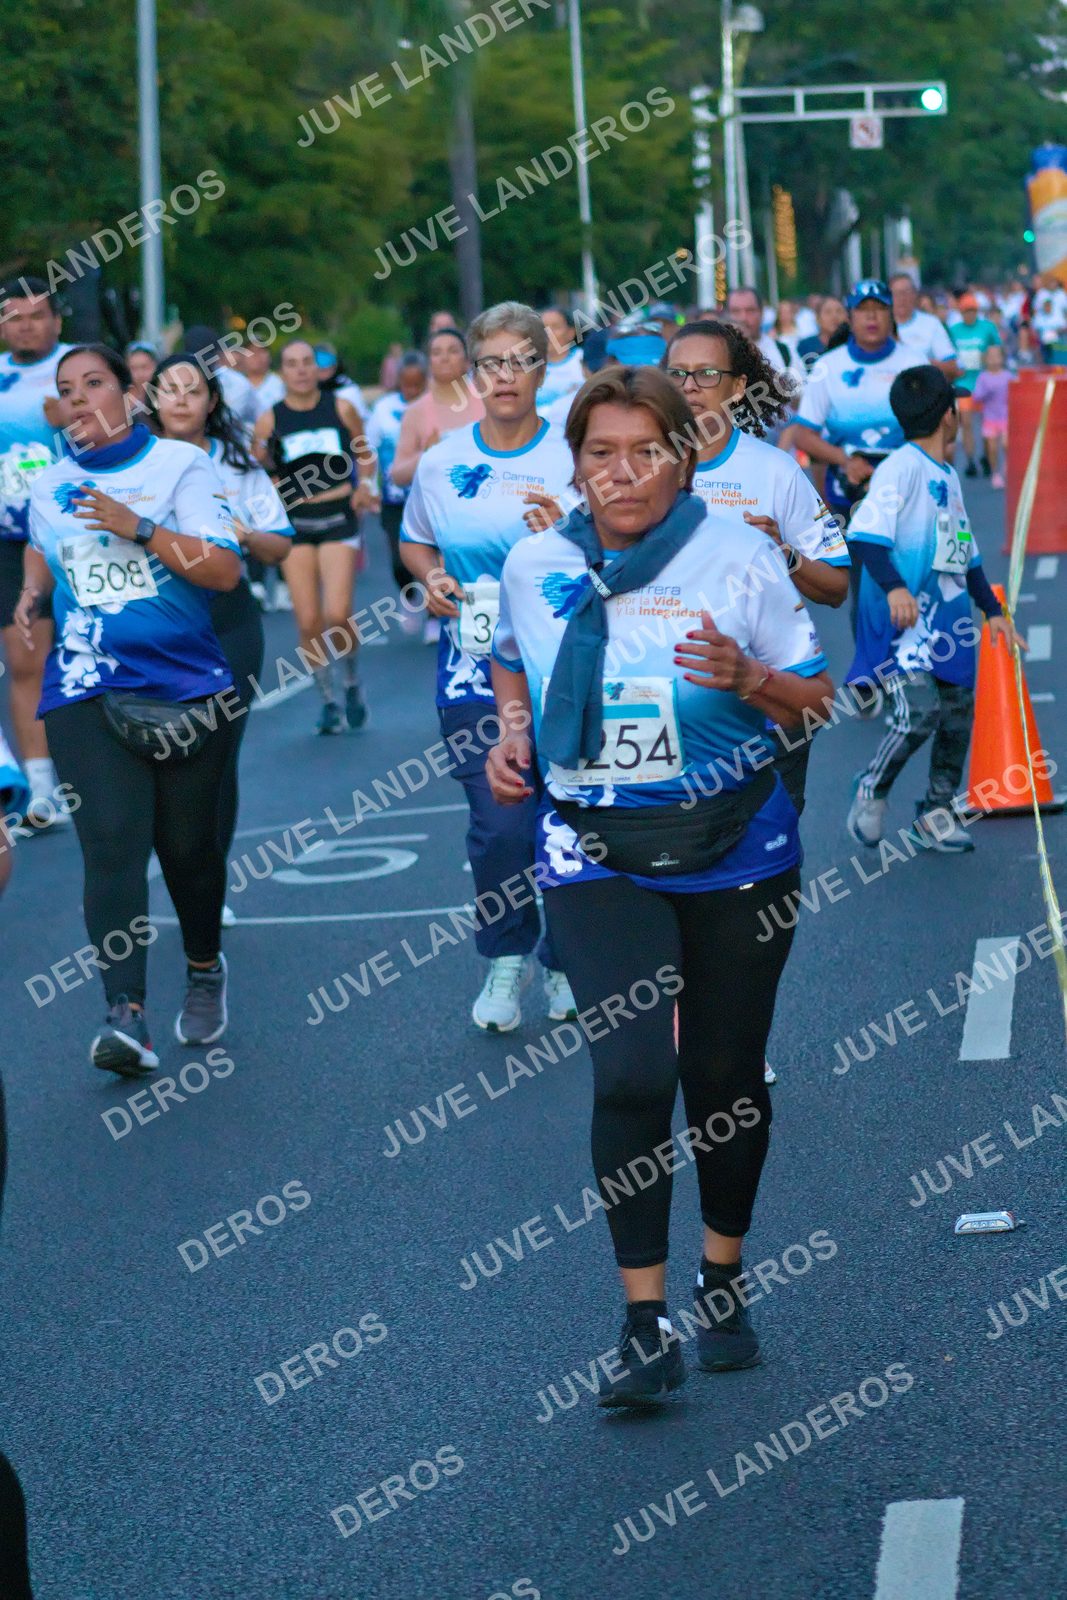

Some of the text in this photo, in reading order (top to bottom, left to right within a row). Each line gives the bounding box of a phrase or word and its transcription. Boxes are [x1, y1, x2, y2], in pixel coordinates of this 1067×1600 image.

[695, 478, 742, 490] Carrera
[721, 490, 742, 498] Vida
[711, 498, 758, 507] Integridad
[946, 539, 970, 565] 25
[630, 584, 681, 596] arrera
[616, 596, 682, 607] por la Vida
[616, 606, 707, 619] y la Integridad
